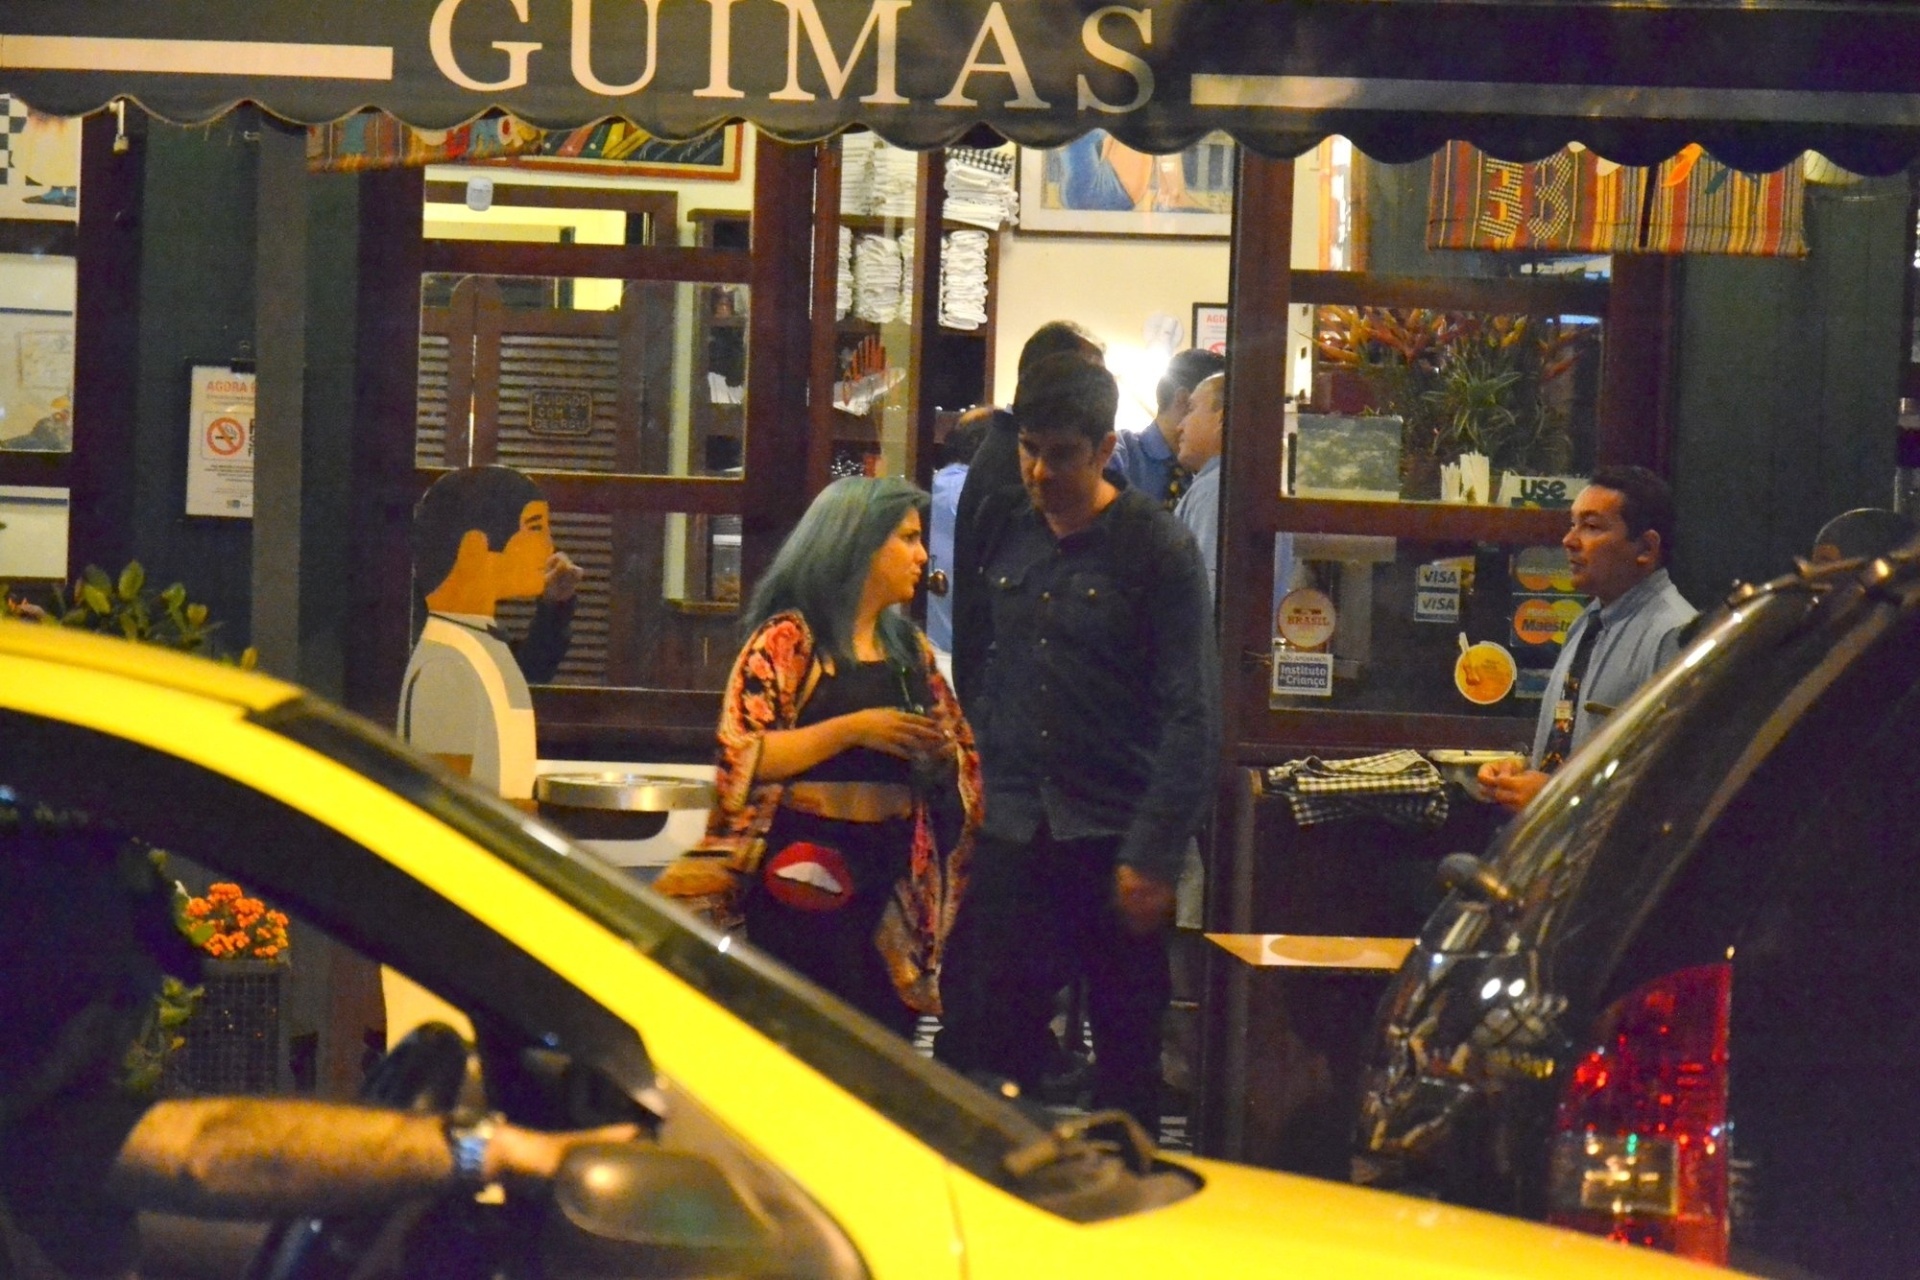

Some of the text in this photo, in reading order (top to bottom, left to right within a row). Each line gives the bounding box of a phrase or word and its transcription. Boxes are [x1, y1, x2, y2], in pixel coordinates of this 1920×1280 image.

[429, 0, 1156, 115] GUIMAS
[1206, 314, 1226, 324] AGO
[207, 381, 247, 393] AGORA
[1422, 570, 1457, 584] VISA
[1421, 597, 1456, 610] VISA
[1287, 615, 1330, 626] BRASIL
[1521, 618, 1571, 632] Maestr
[1281, 664, 1327, 677] Instituto
[1286, 674, 1326, 689] Criança
